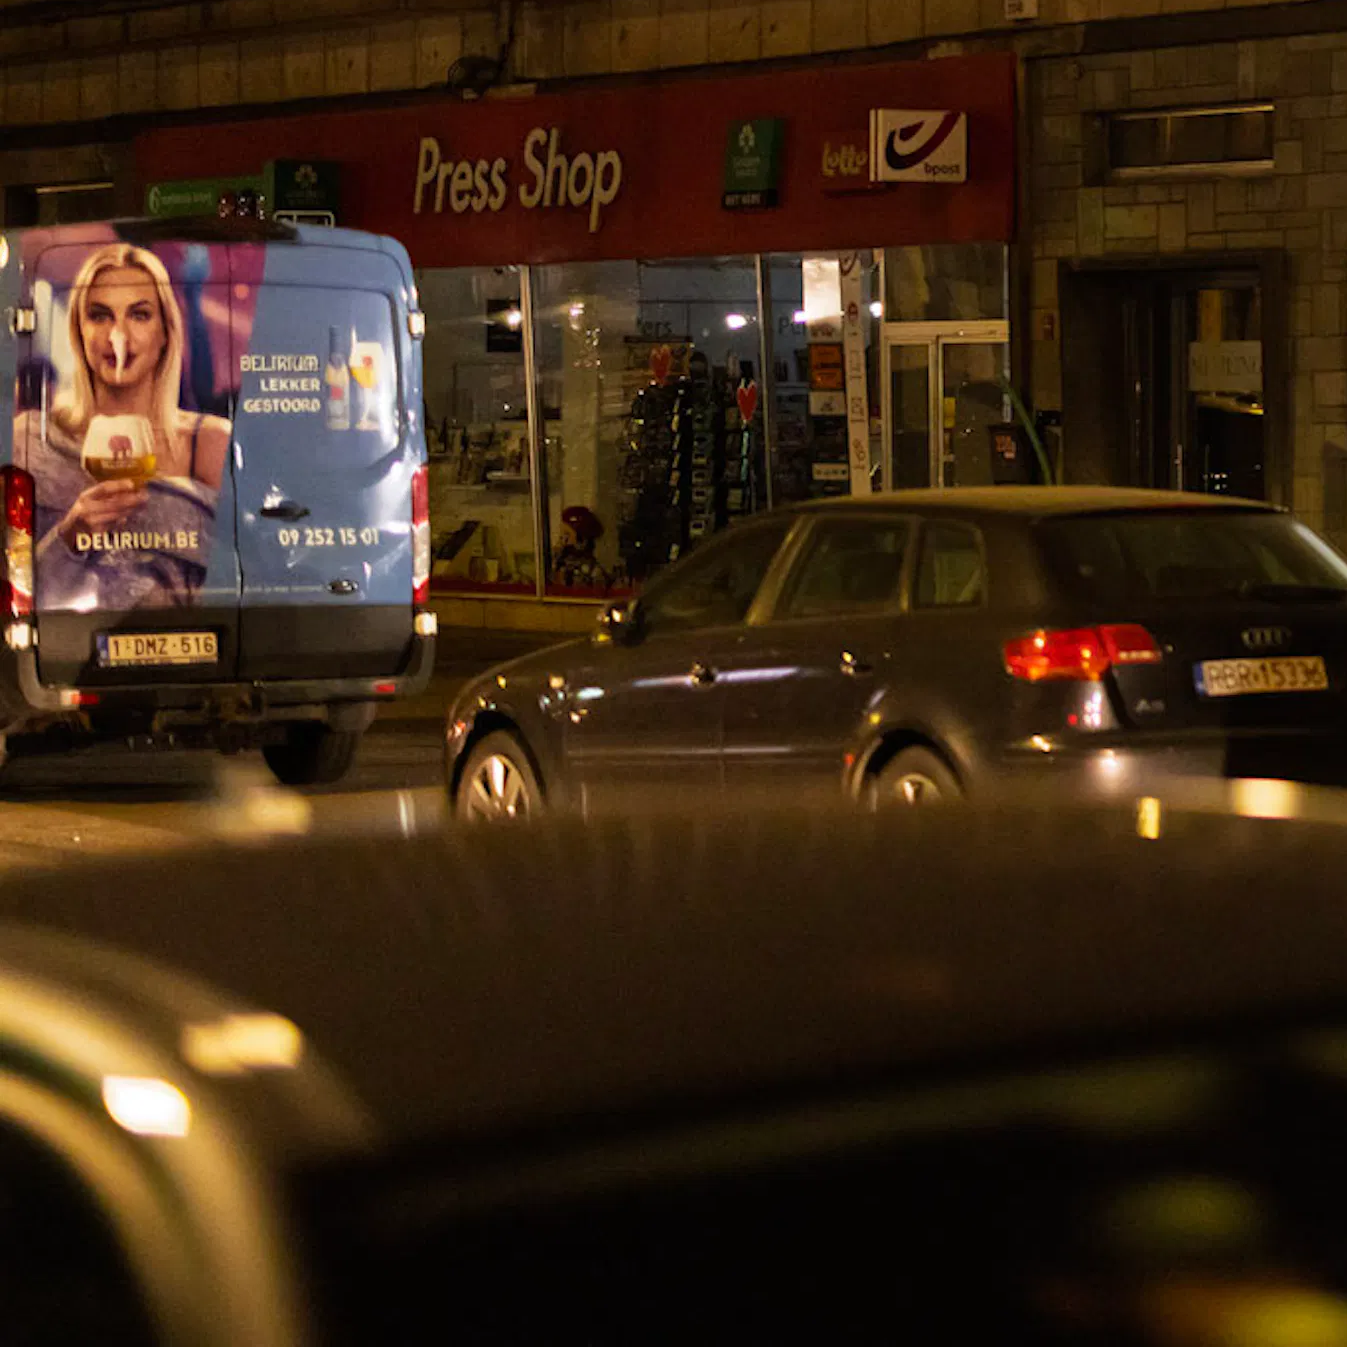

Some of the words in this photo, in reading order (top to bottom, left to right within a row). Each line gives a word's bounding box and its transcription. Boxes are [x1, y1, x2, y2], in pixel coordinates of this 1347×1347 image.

[924, 163, 961, 176] bpost
[413, 136, 507, 214] Press
[518, 126, 622, 234] Shop
[240, 355, 319, 372] DELIRIUM
[260, 378, 321, 392] LEKKER
[243, 398, 321, 413] GESTOORD
[76, 531, 199, 551] DELIRIUM.BE
[279, 528, 299, 546] 09
[305, 528, 334, 546] 252
[340, 528, 356, 545] 15
[360, 528, 379, 545] 01
